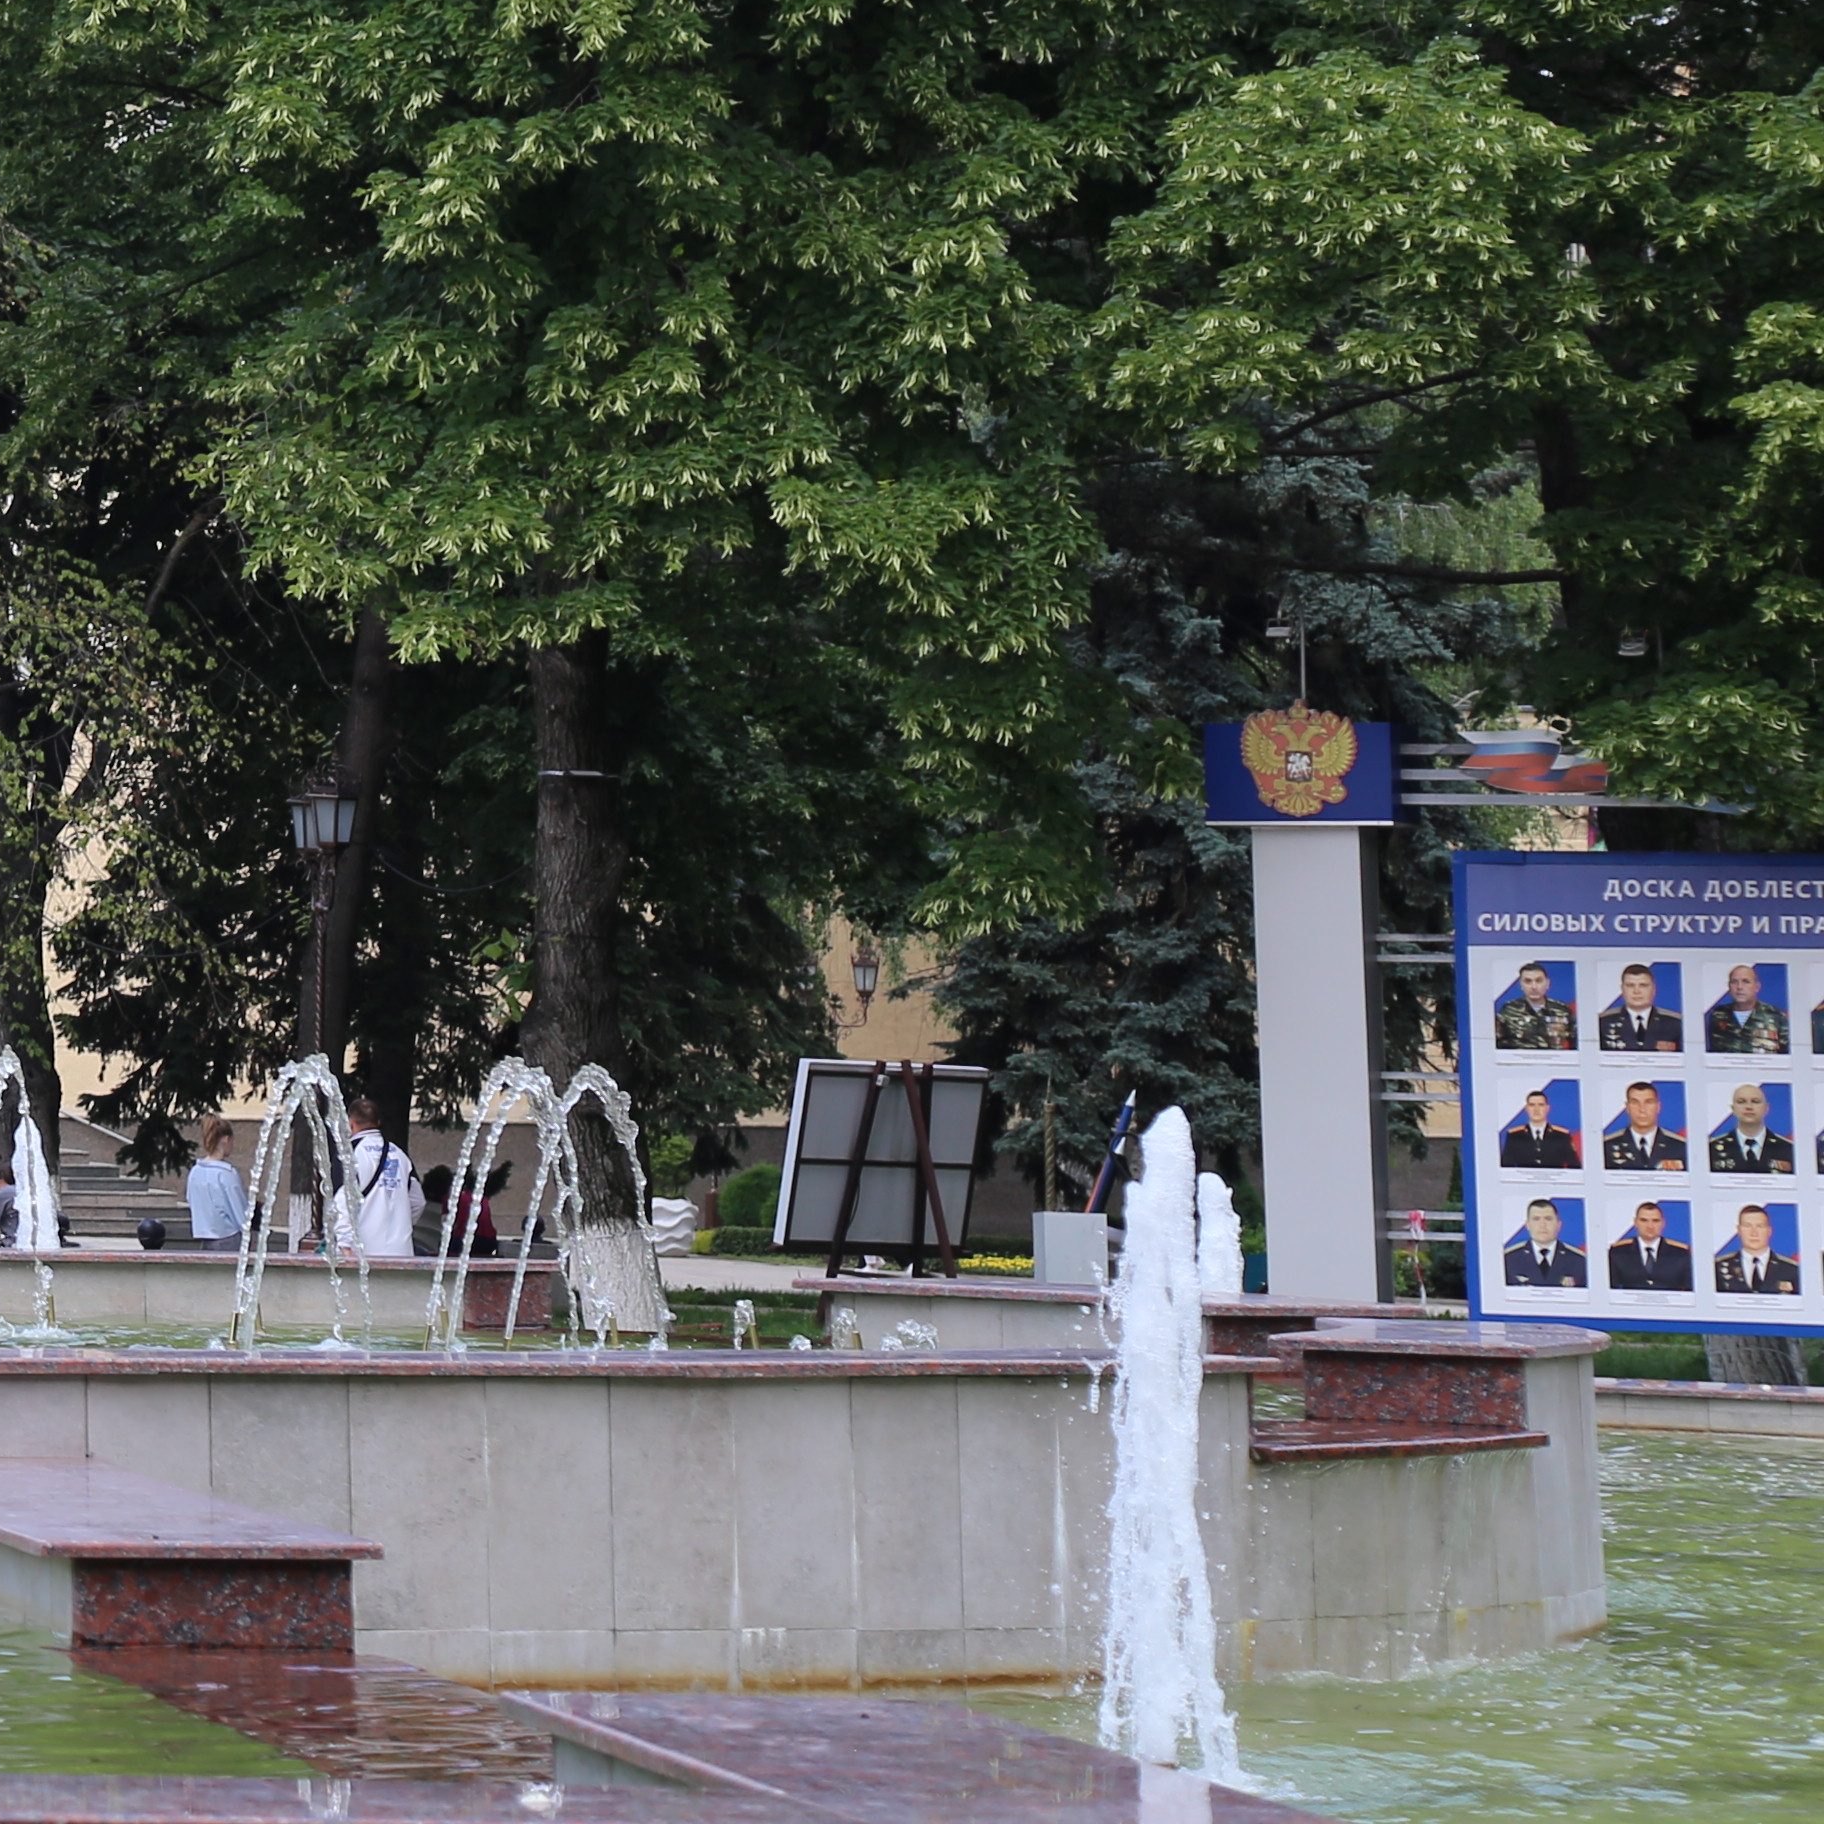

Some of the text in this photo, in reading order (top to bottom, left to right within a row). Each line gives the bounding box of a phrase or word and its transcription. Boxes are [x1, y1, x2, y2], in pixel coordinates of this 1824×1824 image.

[1604, 878, 1695, 902] ДОСКА
[1477, 913, 1605, 933] СИЛОВЫХ
[1614, 914, 1743, 934] СТРУКТУР
[1752, 916, 1772, 934] И
